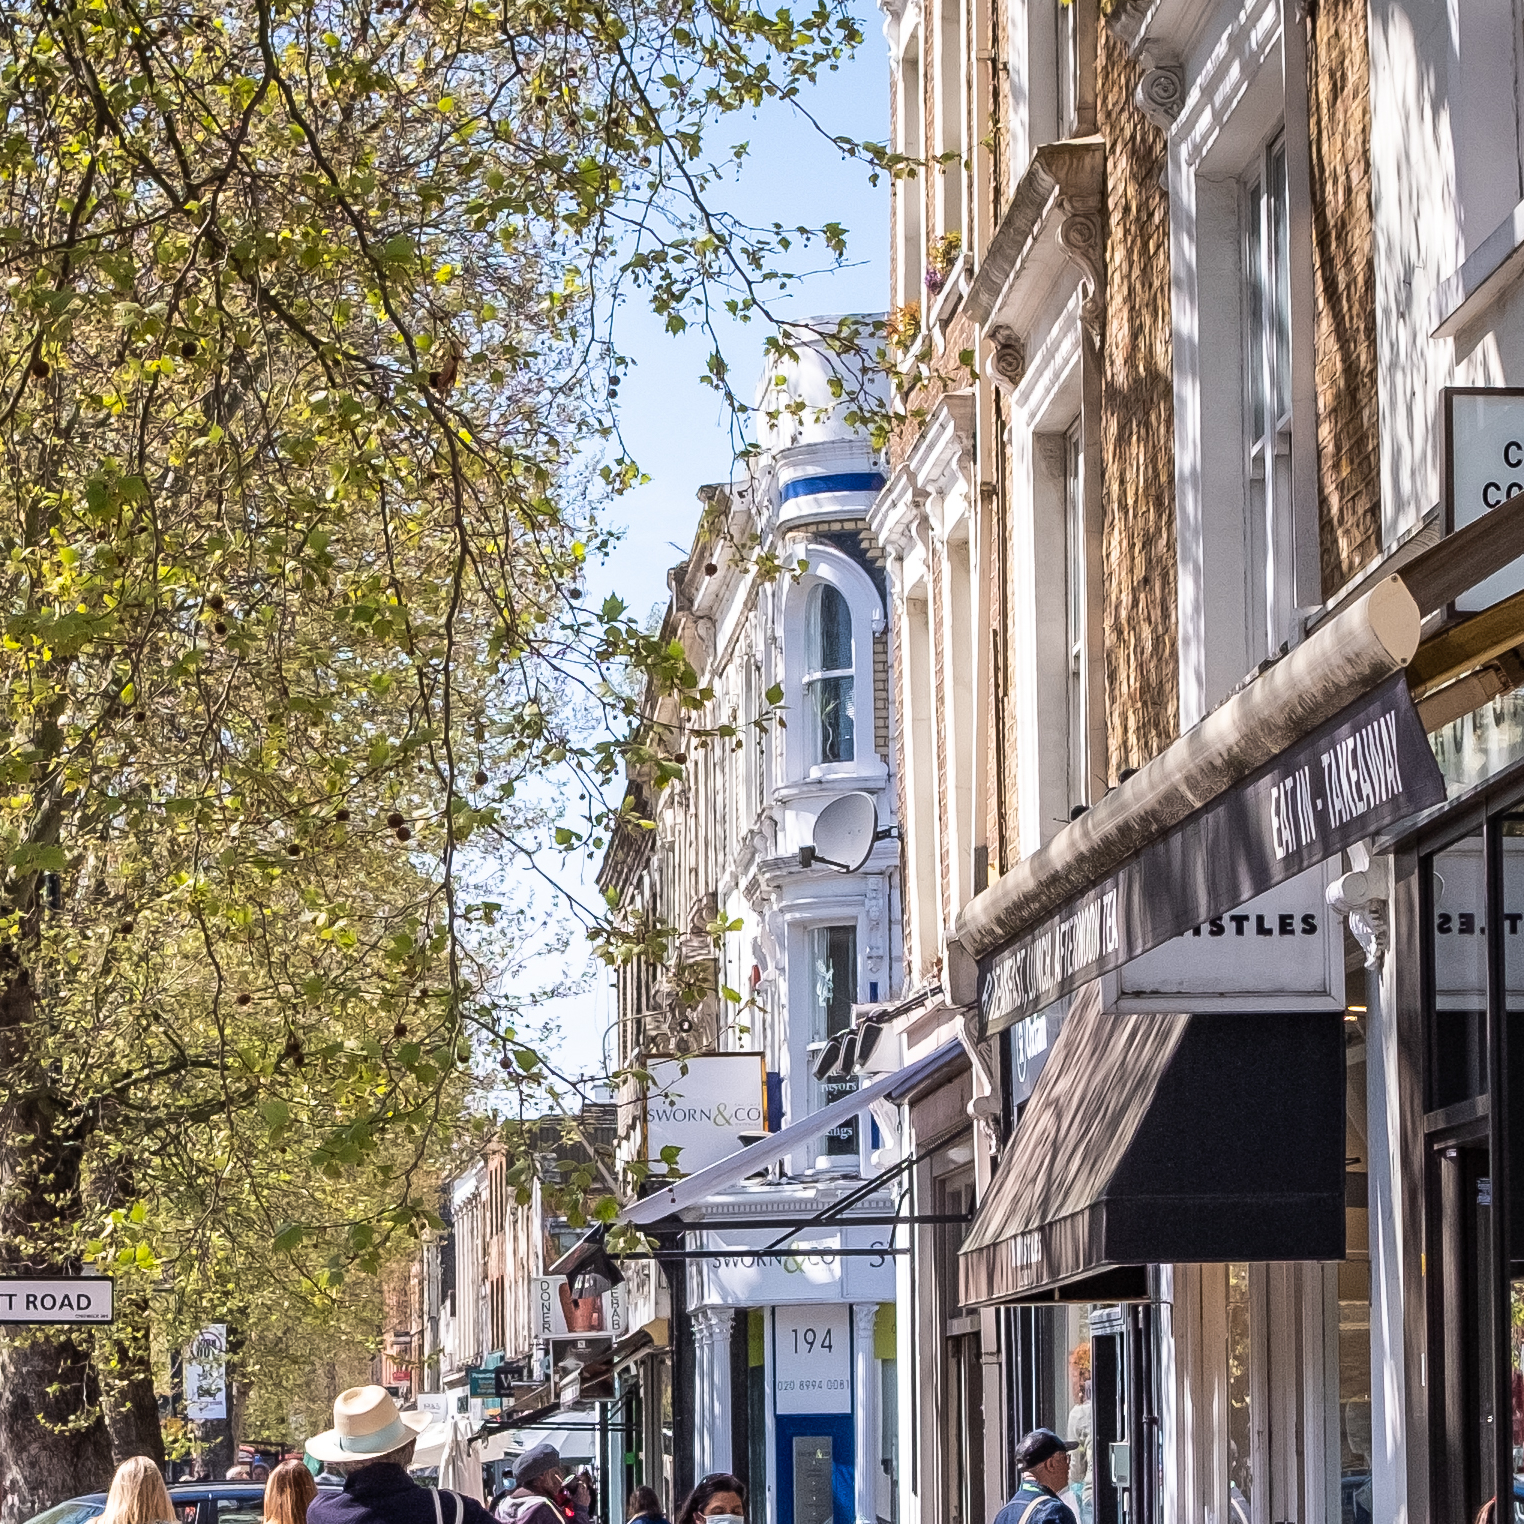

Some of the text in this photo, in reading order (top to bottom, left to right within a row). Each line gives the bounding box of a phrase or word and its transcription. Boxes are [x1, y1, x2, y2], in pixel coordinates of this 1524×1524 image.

[1270, 775, 1296, 861] EAT
[1295, 765, 1316, 846] IN
[1320, 709, 1403, 830] TAKEAWAY
[1102, 887, 1119, 957] TEA
[1192, 913, 1318, 937] ISTLES
[25, 1293, 92, 1311] ROAD
[540, 1281, 551, 1333] DONER
[791, 1327, 833, 1354] 194
[777, 1380, 795, 1391] 020
